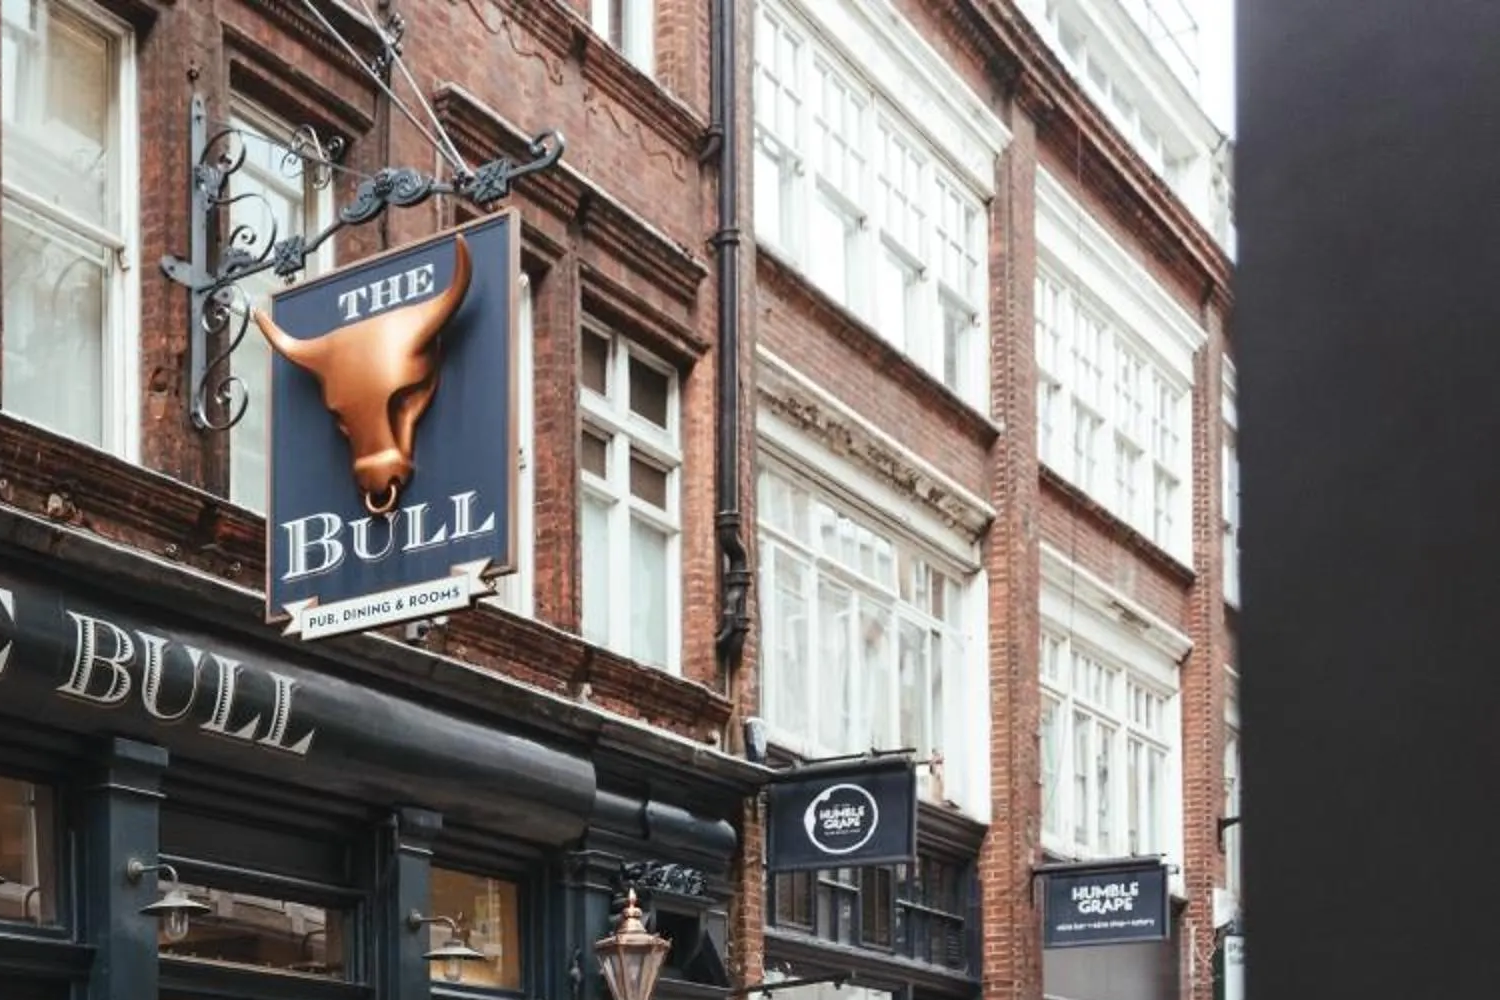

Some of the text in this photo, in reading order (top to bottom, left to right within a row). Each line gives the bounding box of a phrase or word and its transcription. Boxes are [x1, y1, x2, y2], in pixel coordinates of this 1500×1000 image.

[338, 263, 435, 321] THE
[279, 490, 496, 582] BULL
[343, 602, 391, 621] DINING
[395, 599, 404, 611] &
[409, 586, 460, 607] ROOMS
[55, 610, 316, 757] BULL
[1071, 882, 1139, 901] HUMBLE
[1078, 897, 1133, 914] GRAPE
